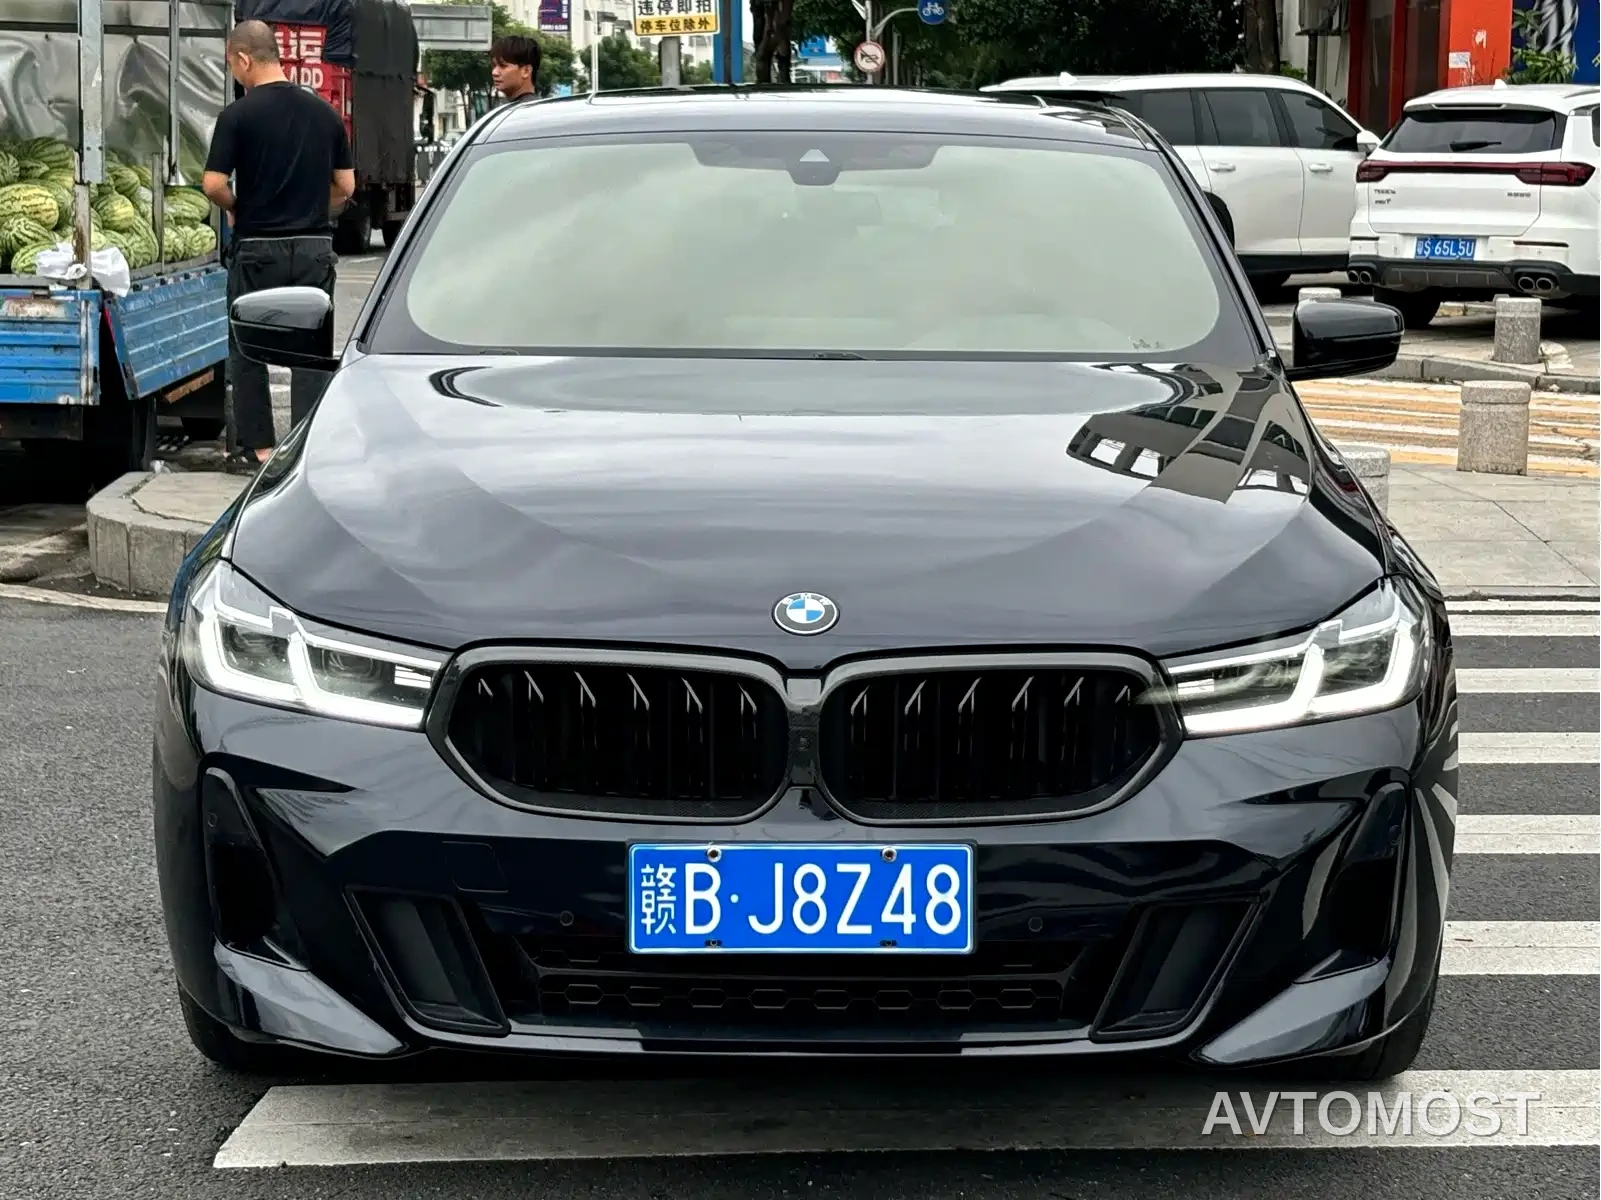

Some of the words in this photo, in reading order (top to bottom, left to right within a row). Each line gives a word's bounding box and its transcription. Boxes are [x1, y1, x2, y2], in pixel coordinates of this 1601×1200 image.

[640, 17, 710, 33] 停车位除外
